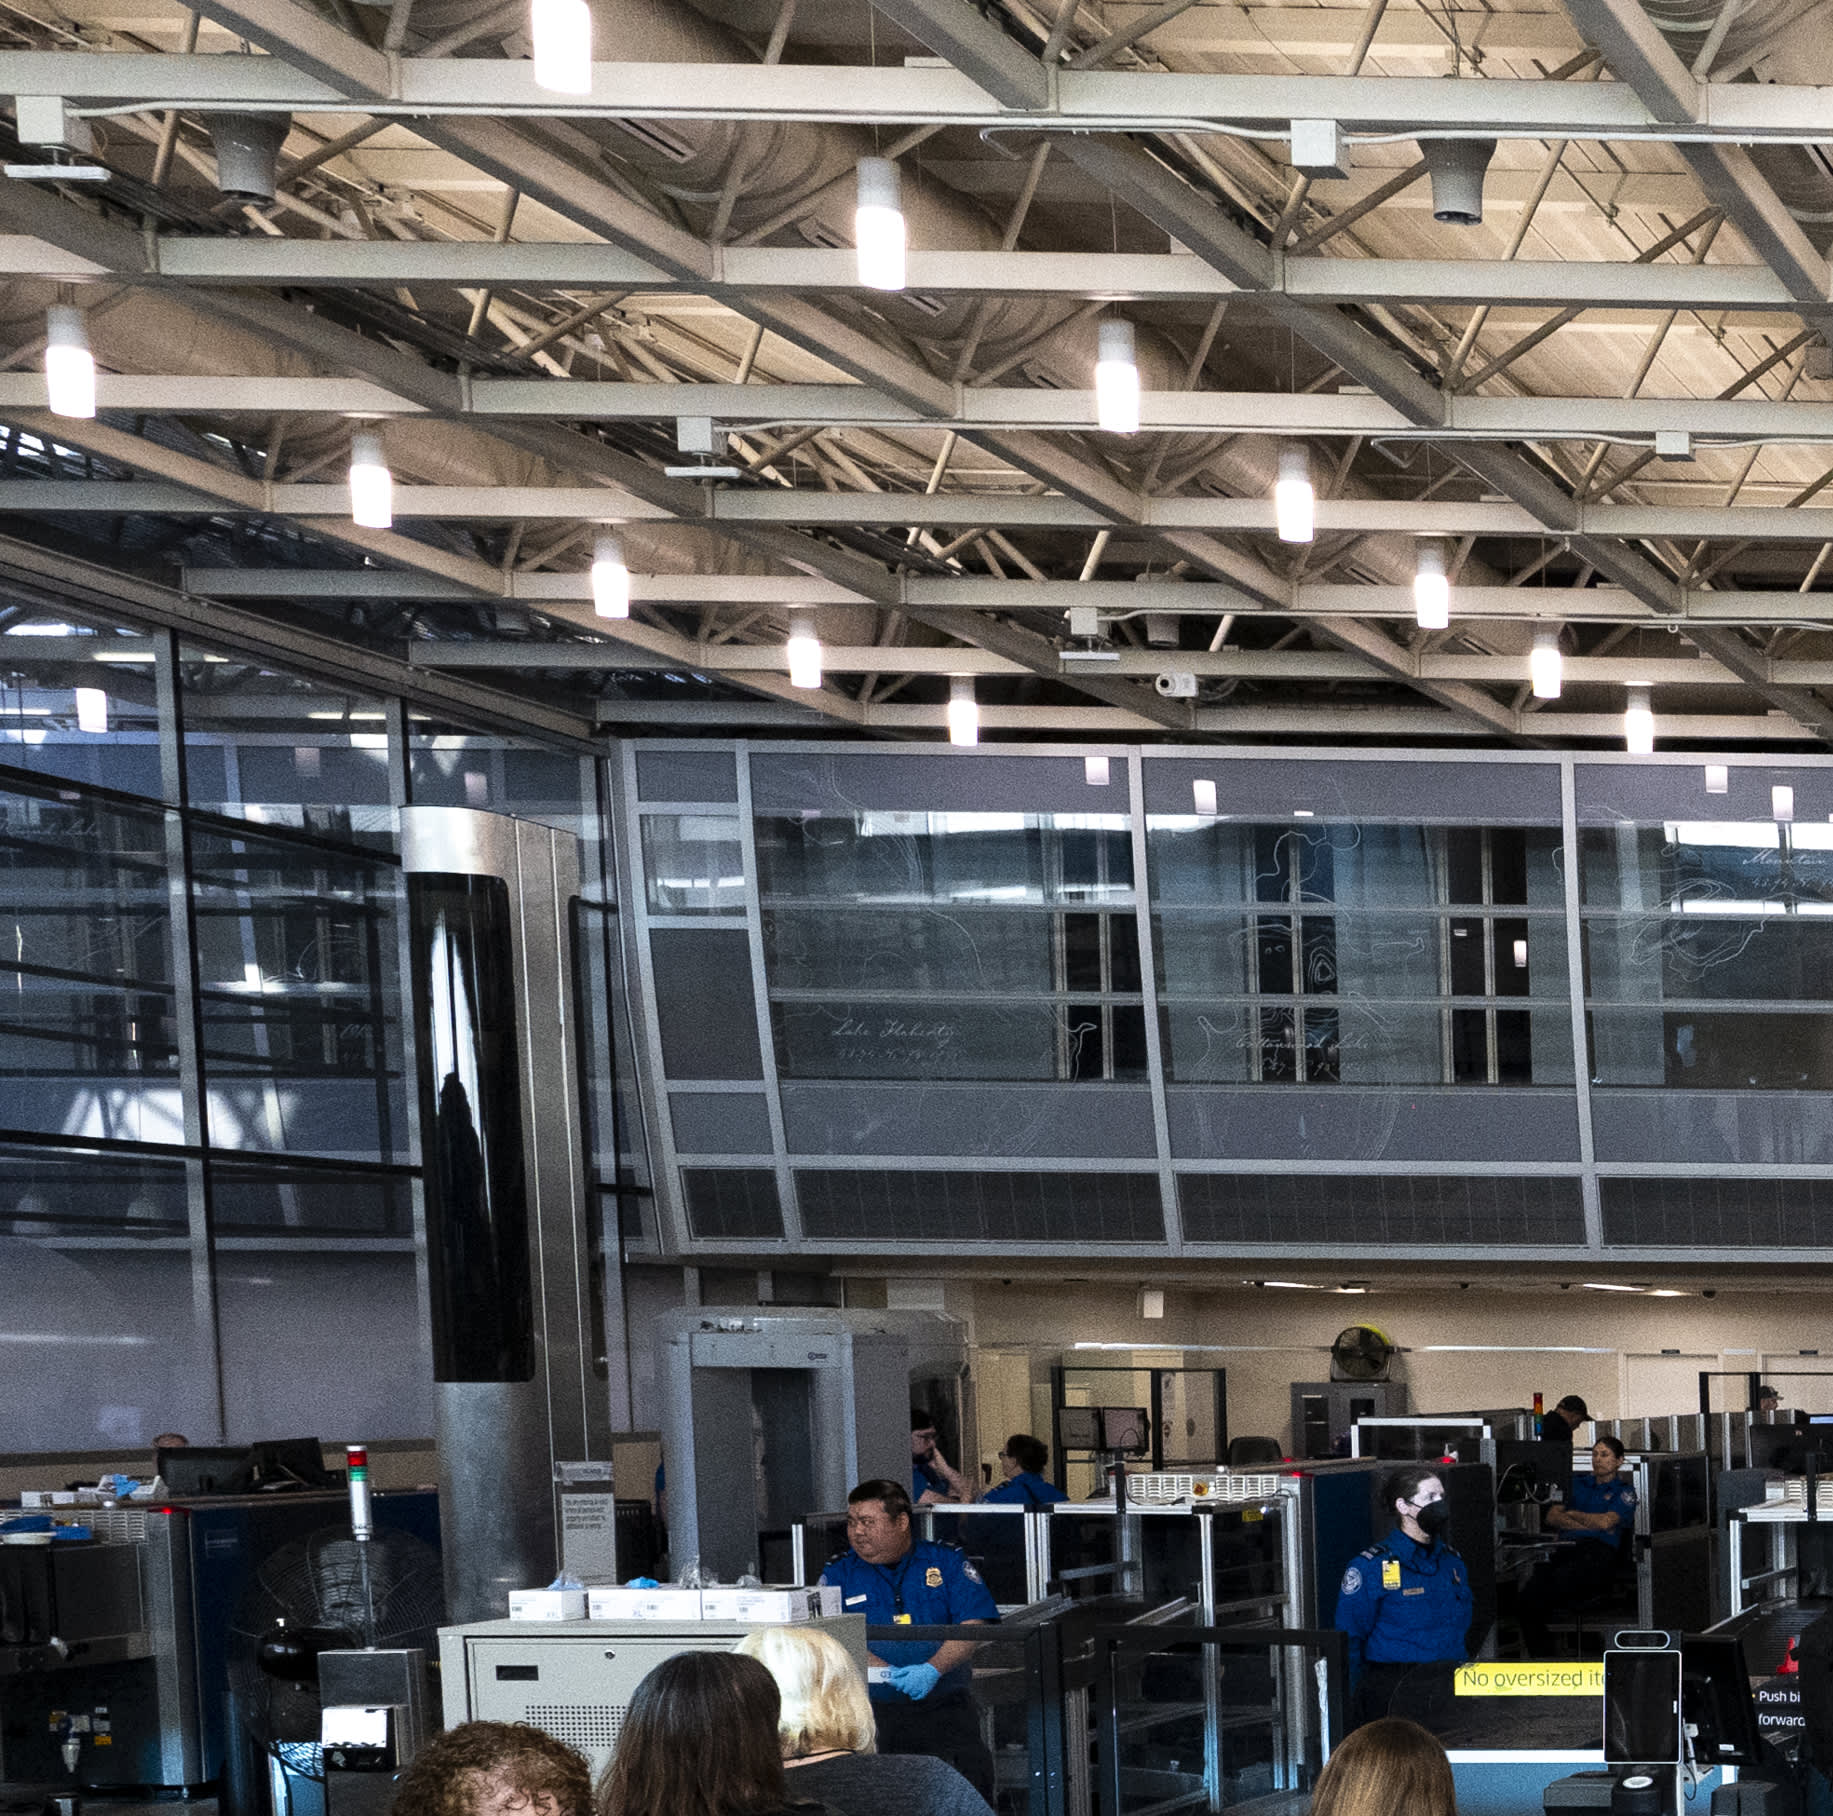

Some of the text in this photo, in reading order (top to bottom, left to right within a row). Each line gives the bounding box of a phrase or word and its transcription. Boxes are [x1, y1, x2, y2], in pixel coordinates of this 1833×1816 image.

[831, 1019, 870, 1037] Lake
[1463, 1670, 1489, 1689] No
[1494, 1669, 1583, 1690] oversized
[1759, 1690, 1802, 1703] Push bi
